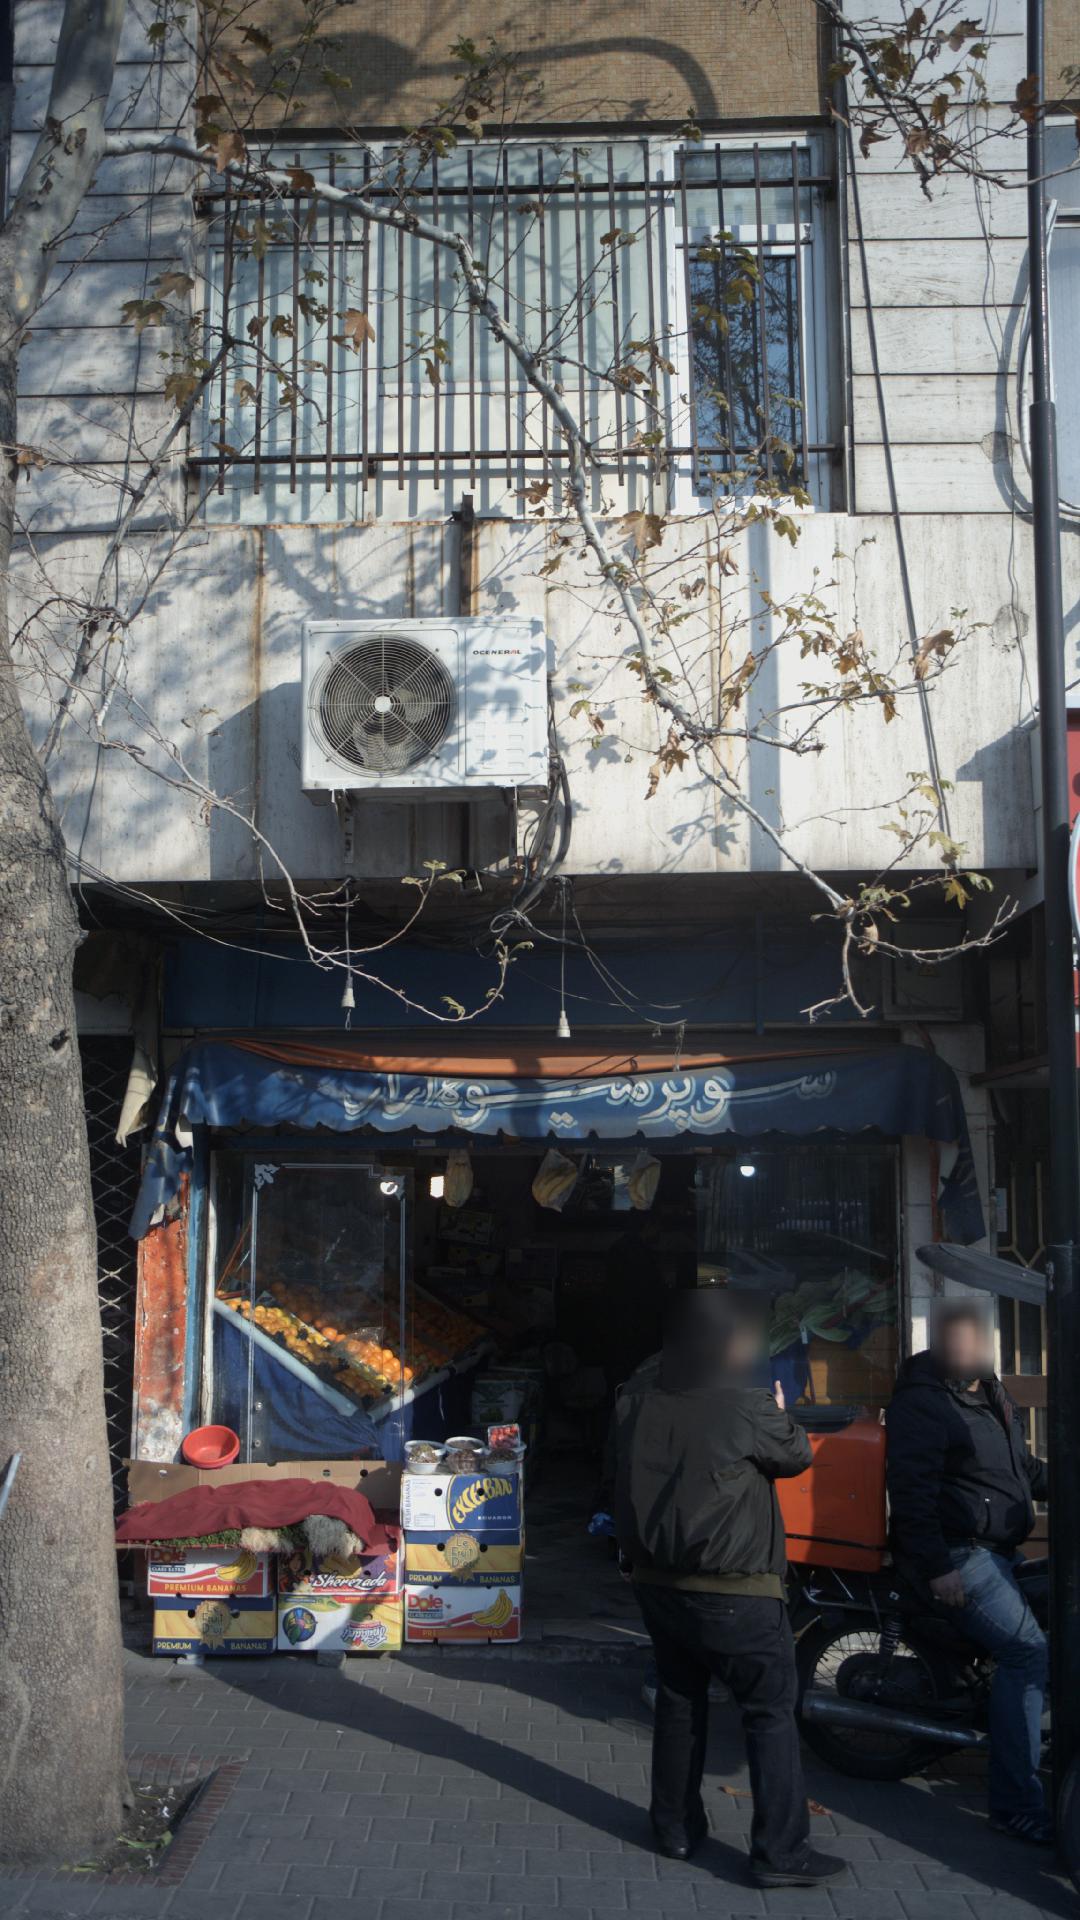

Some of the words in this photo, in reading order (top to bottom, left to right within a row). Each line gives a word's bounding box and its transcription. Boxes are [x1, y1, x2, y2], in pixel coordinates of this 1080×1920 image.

[638, 1069, 838, 1129] سوپر
[312, 1570, 387, 1591] Sherezada
[408, 1574, 443, 1584] PREMIUM
[479, 1575, 516, 1584] BANANAS
[164, 1583, 205, 1592] PREMIUM
[206, 1584, 248, 1593] BANANAS
[407, 1593, 444, 1611] Dole
[157, 1641, 192, 1650] PREMIUM
[230, 1641, 268, 1650] BANANAS
